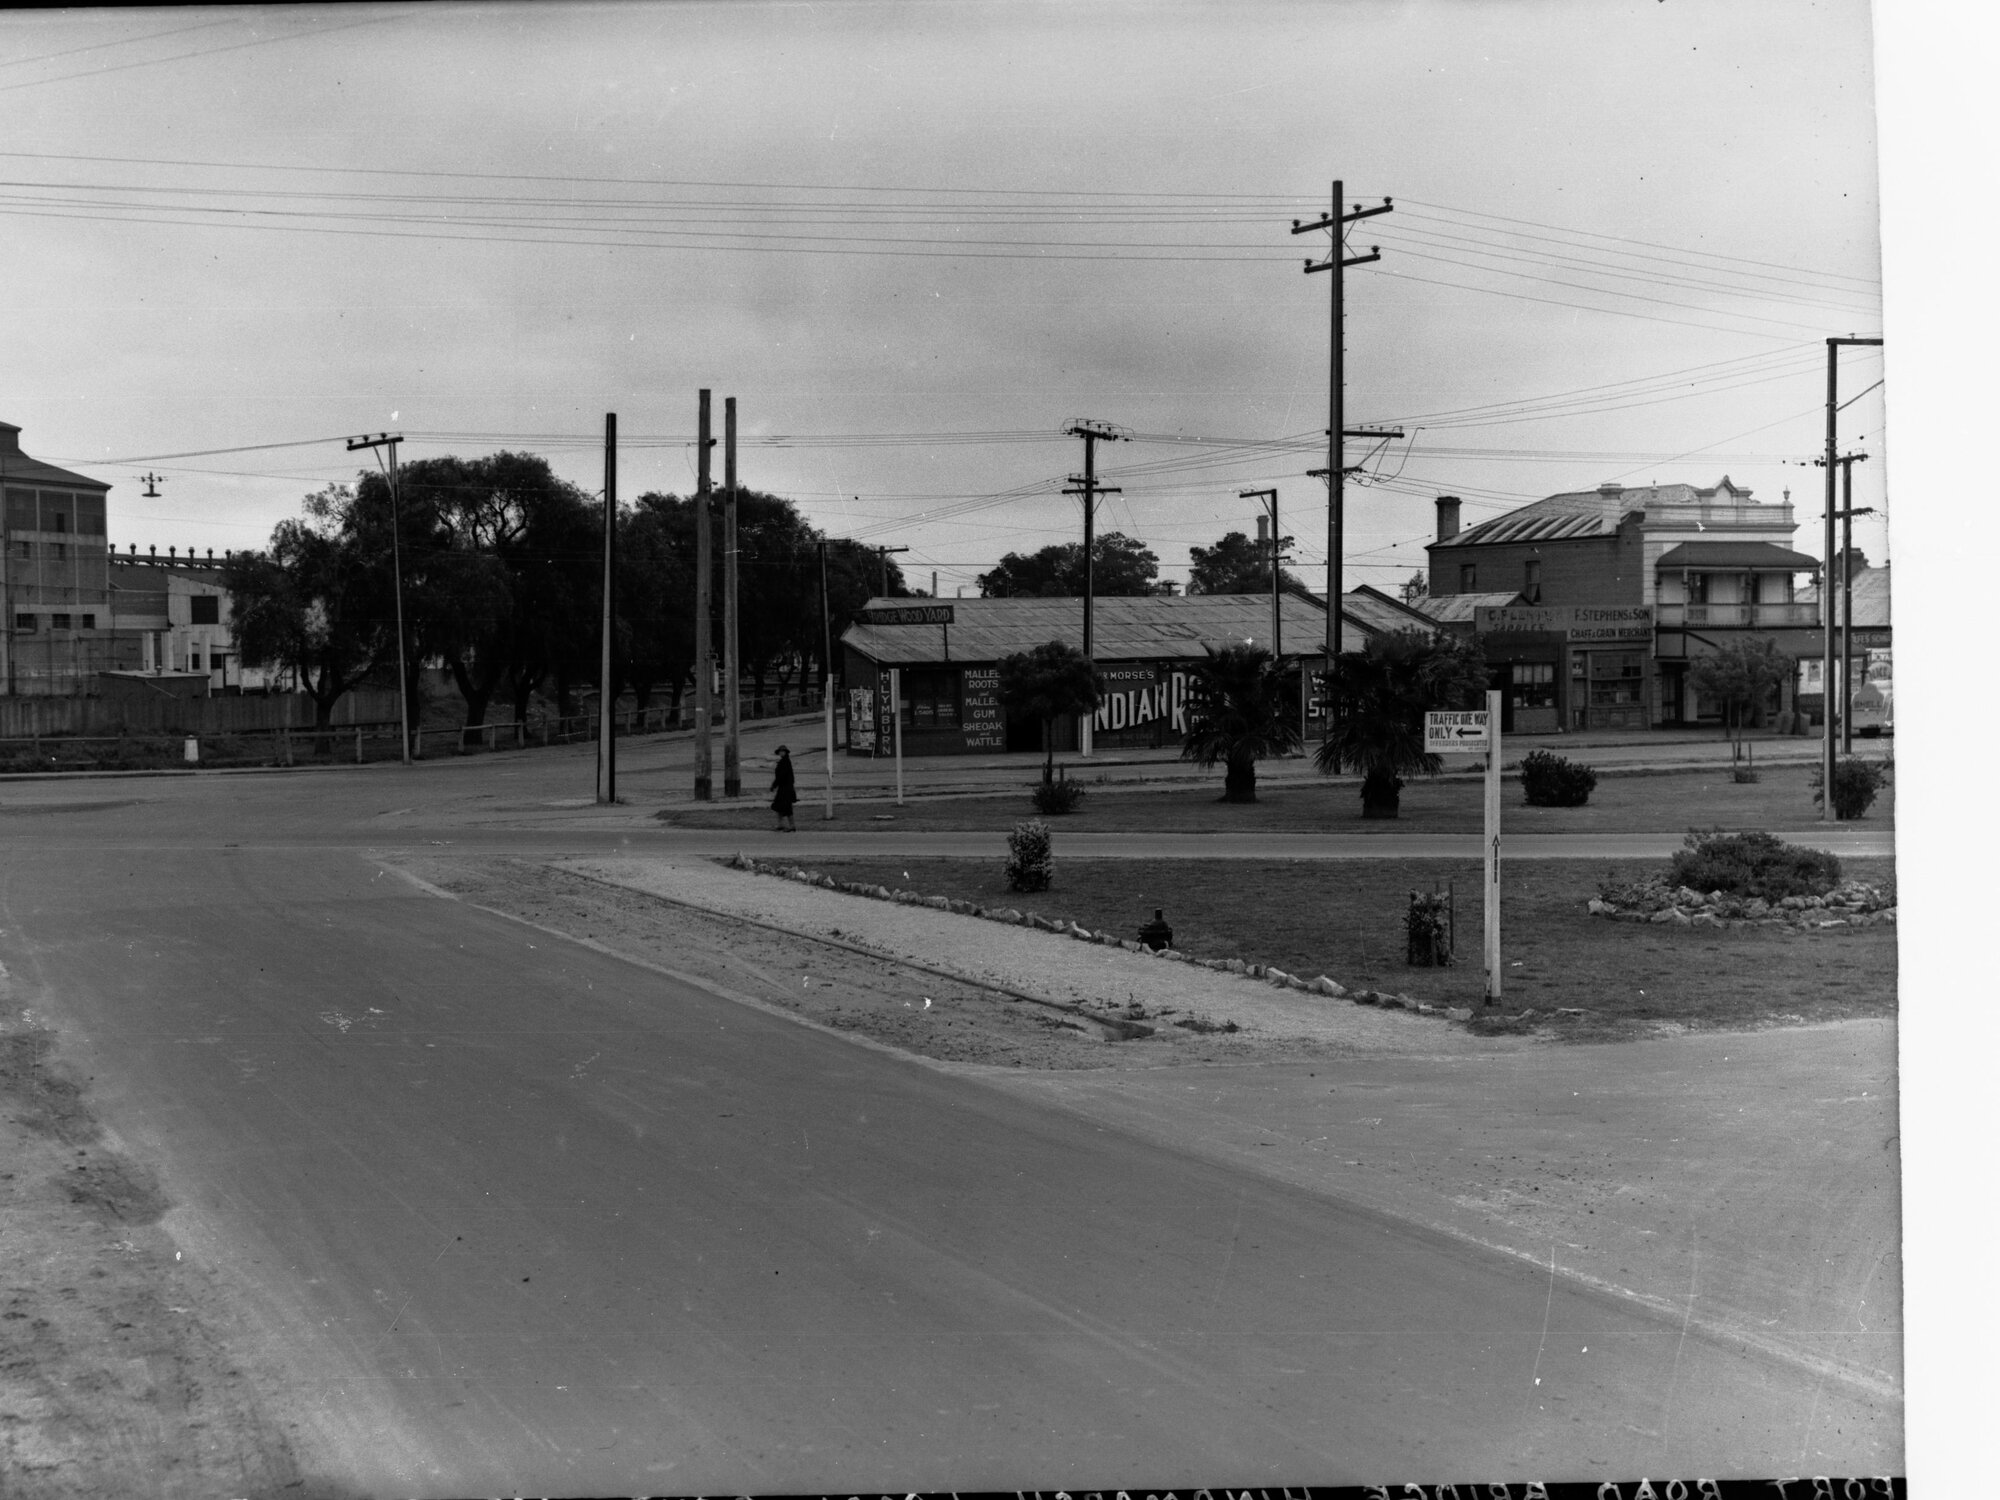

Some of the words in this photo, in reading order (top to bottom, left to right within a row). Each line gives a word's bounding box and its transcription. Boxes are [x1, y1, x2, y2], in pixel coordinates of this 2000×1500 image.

[897, 608, 923, 622] WOOD
[923, 607, 950, 622] YARD
[1633, 608, 1650, 620] SON
[1110, 669, 1154, 680] MORSE'S
[968, 680, 999, 689] ROOTS
[1094, 682, 1168, 731] NDIAN
[973, 709, 996, 719] GUM
[1429, 713, 1459, 725] TRAFFIC
[1474, 713, 1489, 725] WAY
[962, 722, 1004, 732] SHEOAK
[1429, 727, 1452, 739] ONLY
[966, 737, 1003, 747] WATTLE
